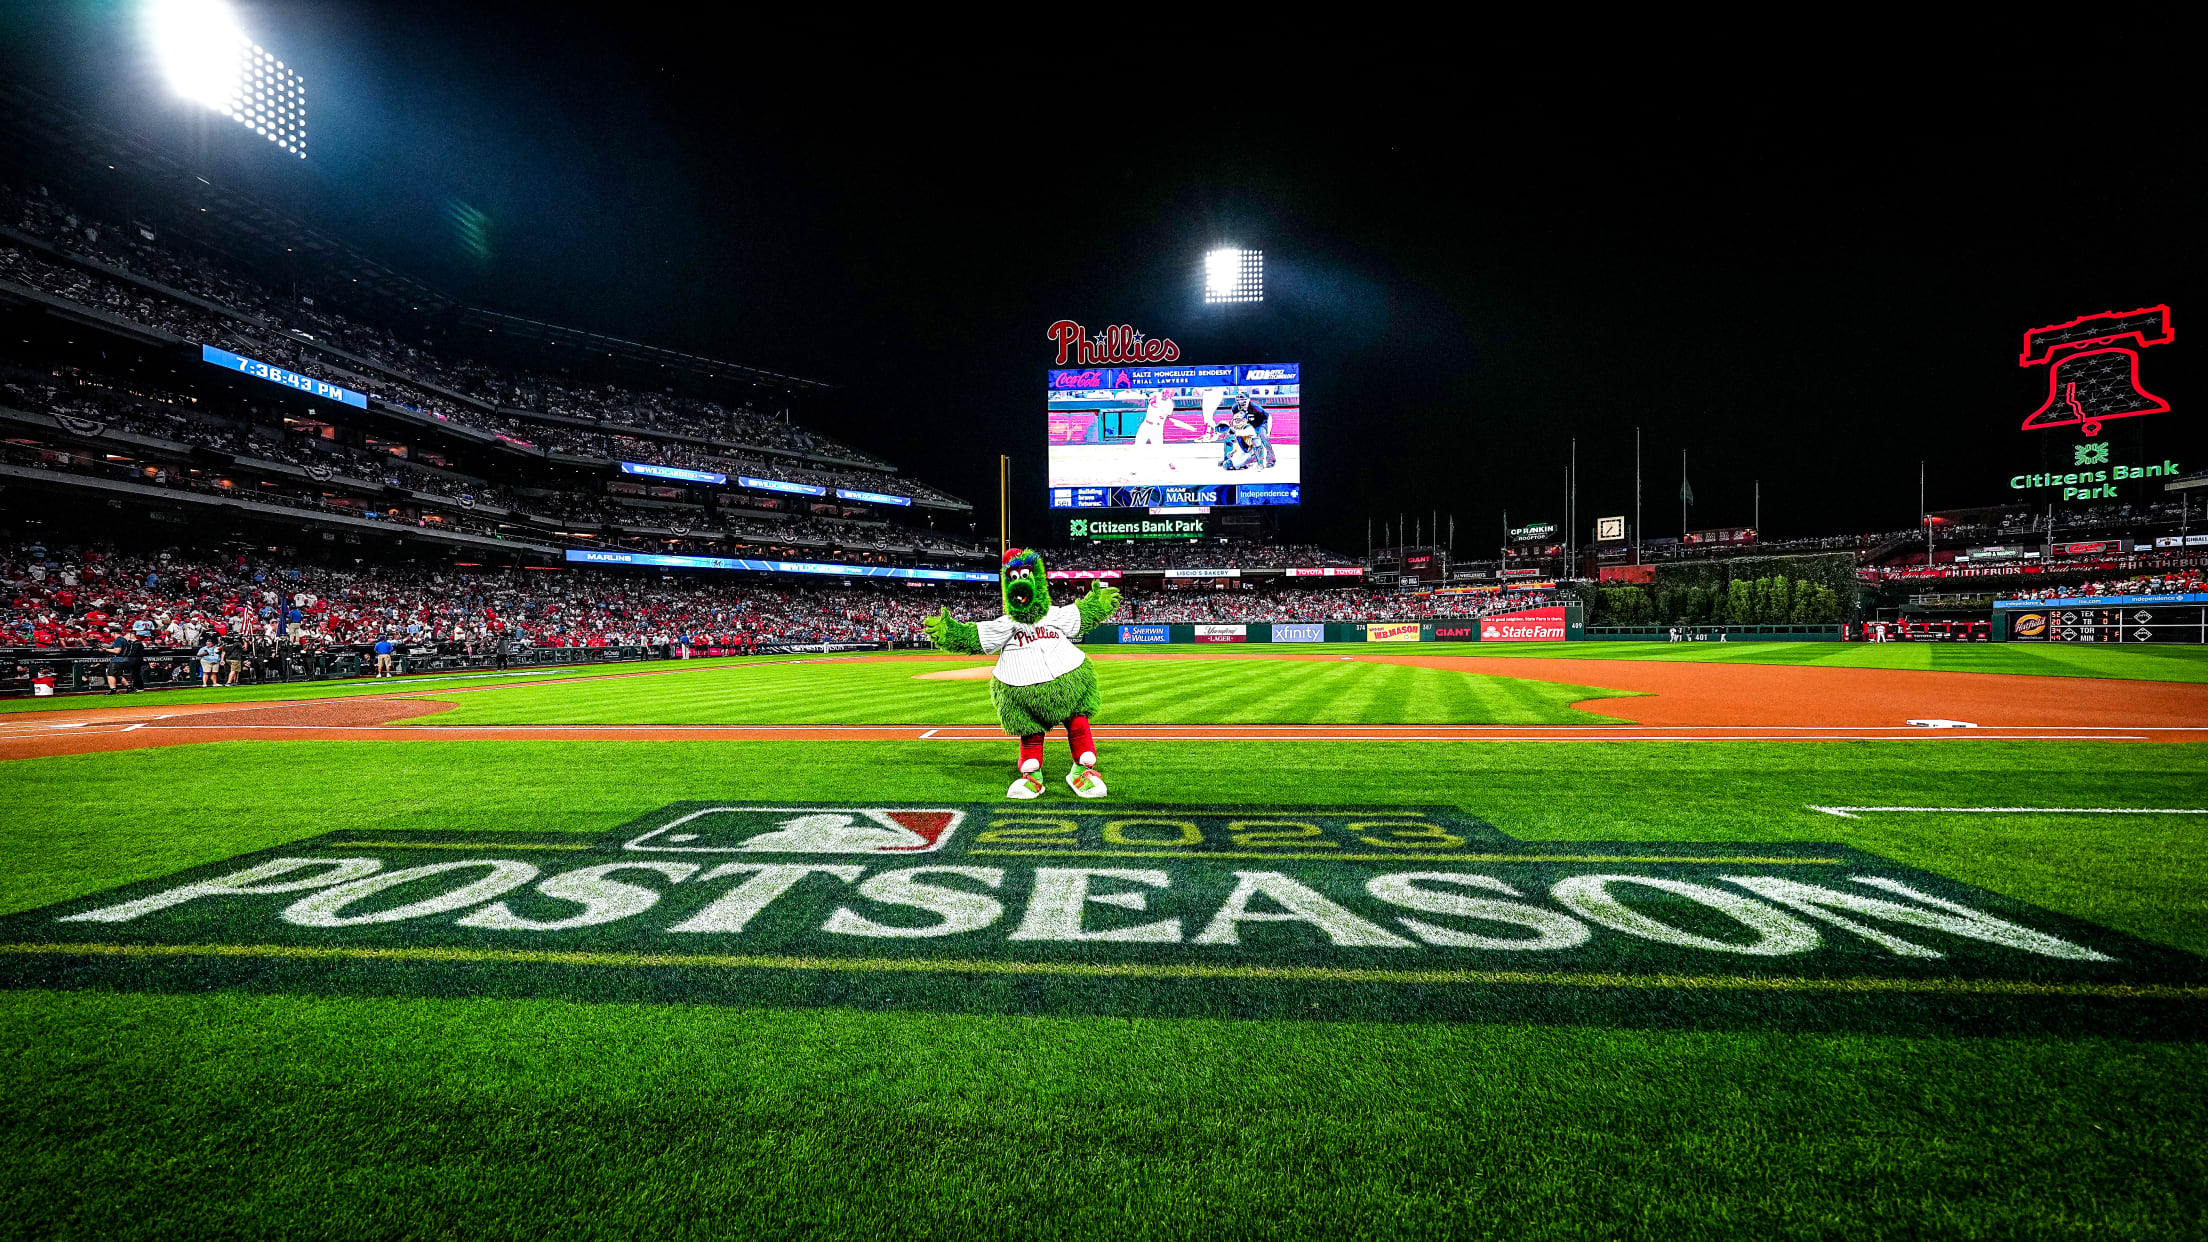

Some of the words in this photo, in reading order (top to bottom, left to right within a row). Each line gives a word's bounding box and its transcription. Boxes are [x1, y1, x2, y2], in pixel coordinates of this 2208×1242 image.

[1047, 320, 1180, 364] Phillies
[236, 357, 312, 391] 7:36:43
[318, 382, 343, 400] PM
[2010, 470, 2107, 489] Citizens
[2113, 460, 2180, 480] Bank
[1166, 492, 1217, 502] MARLINS
[1240, 489, 1289, 498] Independence
[2063, 483, 2118, 501] Park
[1089, 521, 1140, 533] Citizens
[1142, 520, 1174, 532] Bank
[1175, 519, 1204, 532] Park
[1523, 526, 1554, 534] RANKIN
[587, 553, 631, 562] MARLINS
[1203, 626, 1238, 635] Yuengling
[1435, 628, 1471, 636] GIANT
[1501, 626, 1532, 638] State
[1533, 625, 1564, 638] Farm
[2014, 615, 2047, 633] Hatfield
[1014, 626, 1059, 647] Phillies
[1274, 625, 1321, 641] xfinity
[975, 818, 1466, 850] 2023
[58, 856, 2116, 962] POSTSEASON
